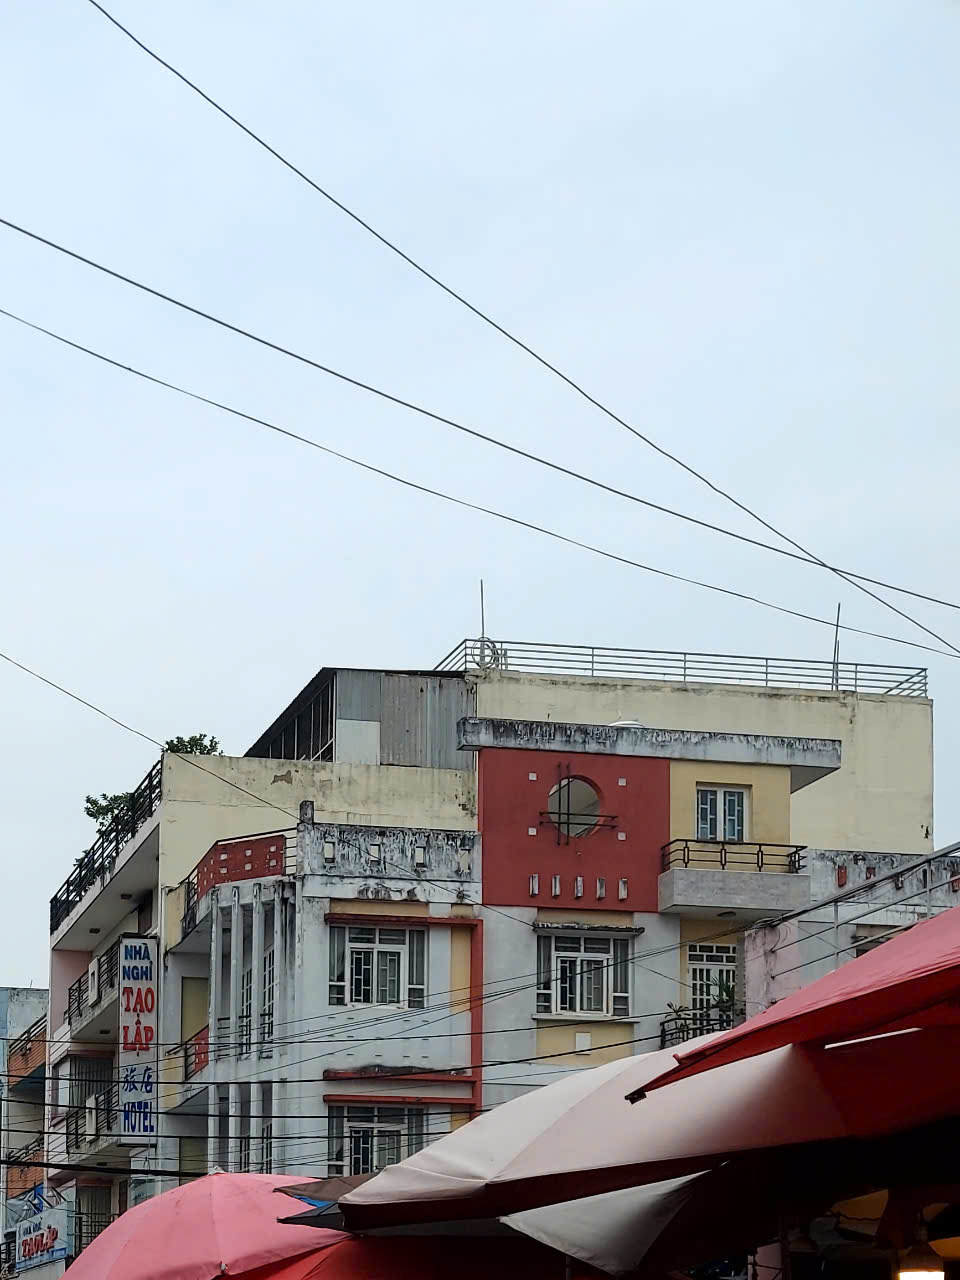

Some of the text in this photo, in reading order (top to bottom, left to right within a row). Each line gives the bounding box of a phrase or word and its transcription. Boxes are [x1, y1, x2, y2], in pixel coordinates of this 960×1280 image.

[124, 942, 151, 961] NHÀ
[122, 961, 153, 981] NGHỈ
[122, 1018, 155, 1057] LẬP
[122, 1066, 154, 1094] 旅店
[123, 1101, 155, 1133] HOTEL
